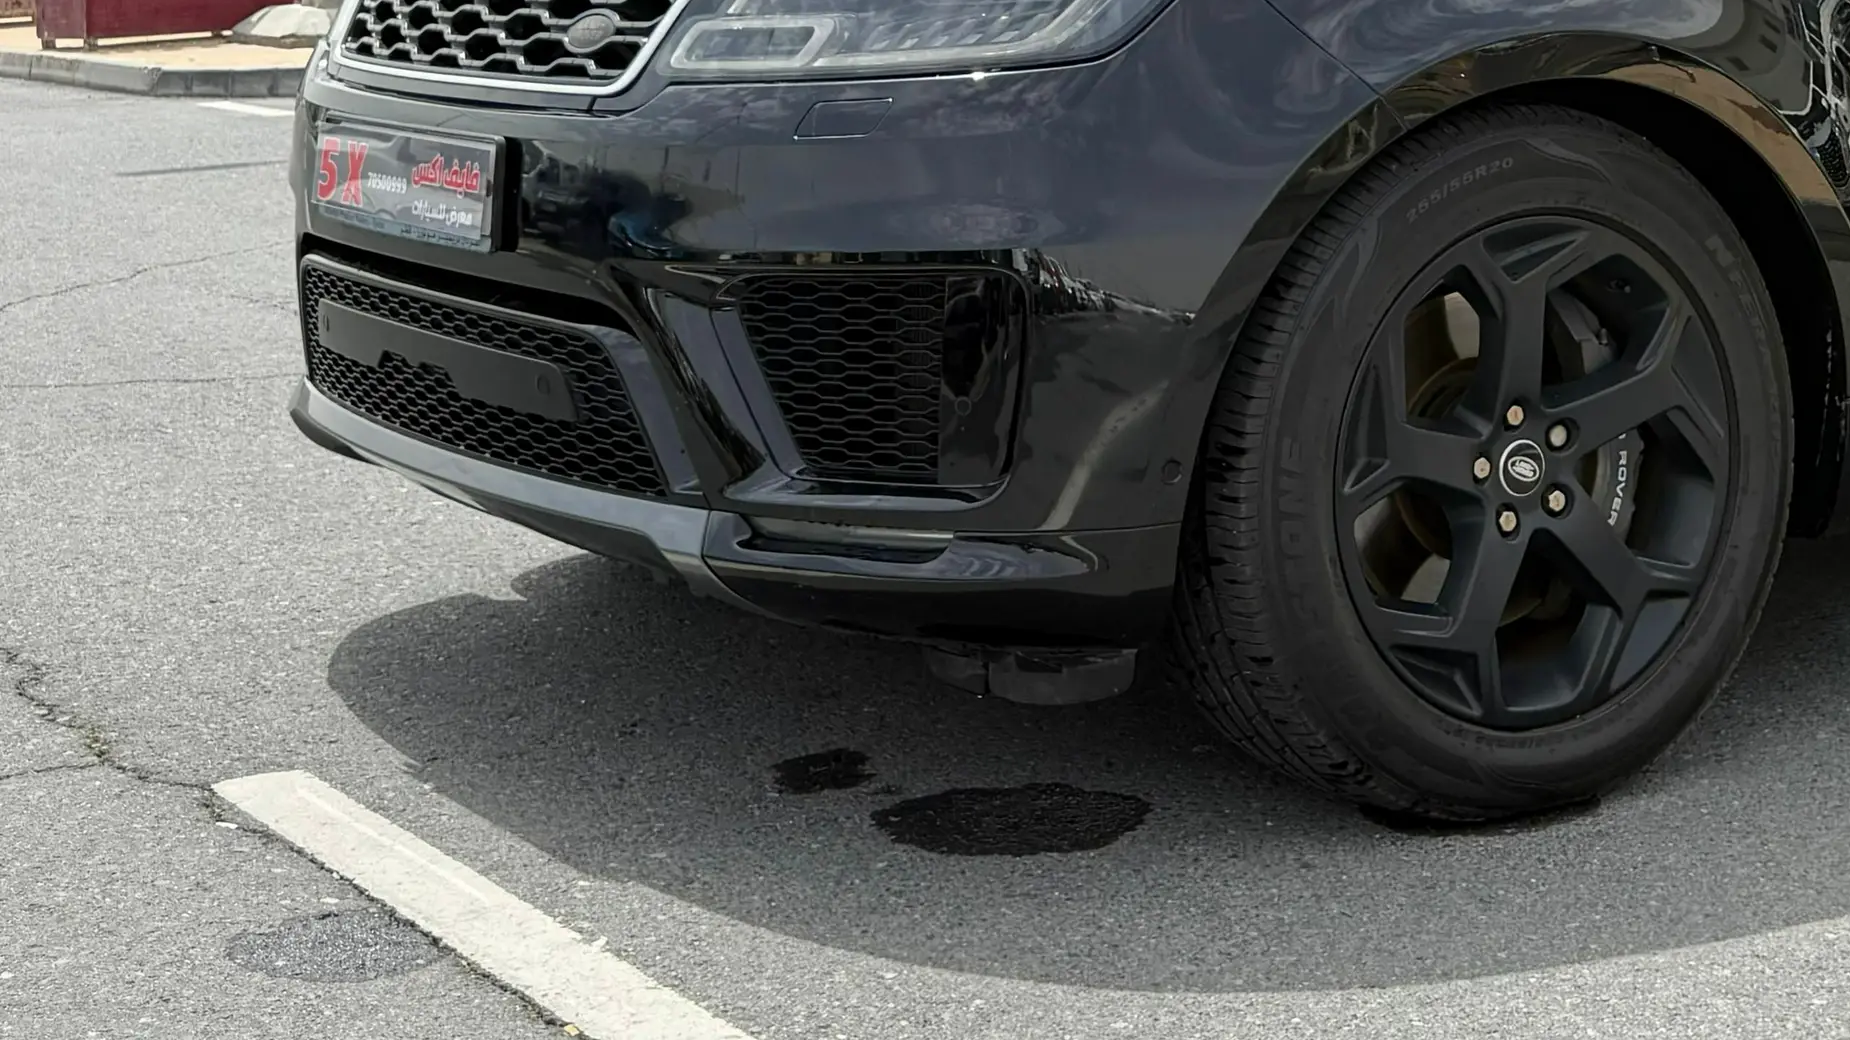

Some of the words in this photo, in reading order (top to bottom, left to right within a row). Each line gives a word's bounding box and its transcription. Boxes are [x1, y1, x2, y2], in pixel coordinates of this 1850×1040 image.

[412, 199, 447, 223] للسيارات
[445, 205, 473, 228] معرض
[1607, 450, 1628, 527] ROVER
